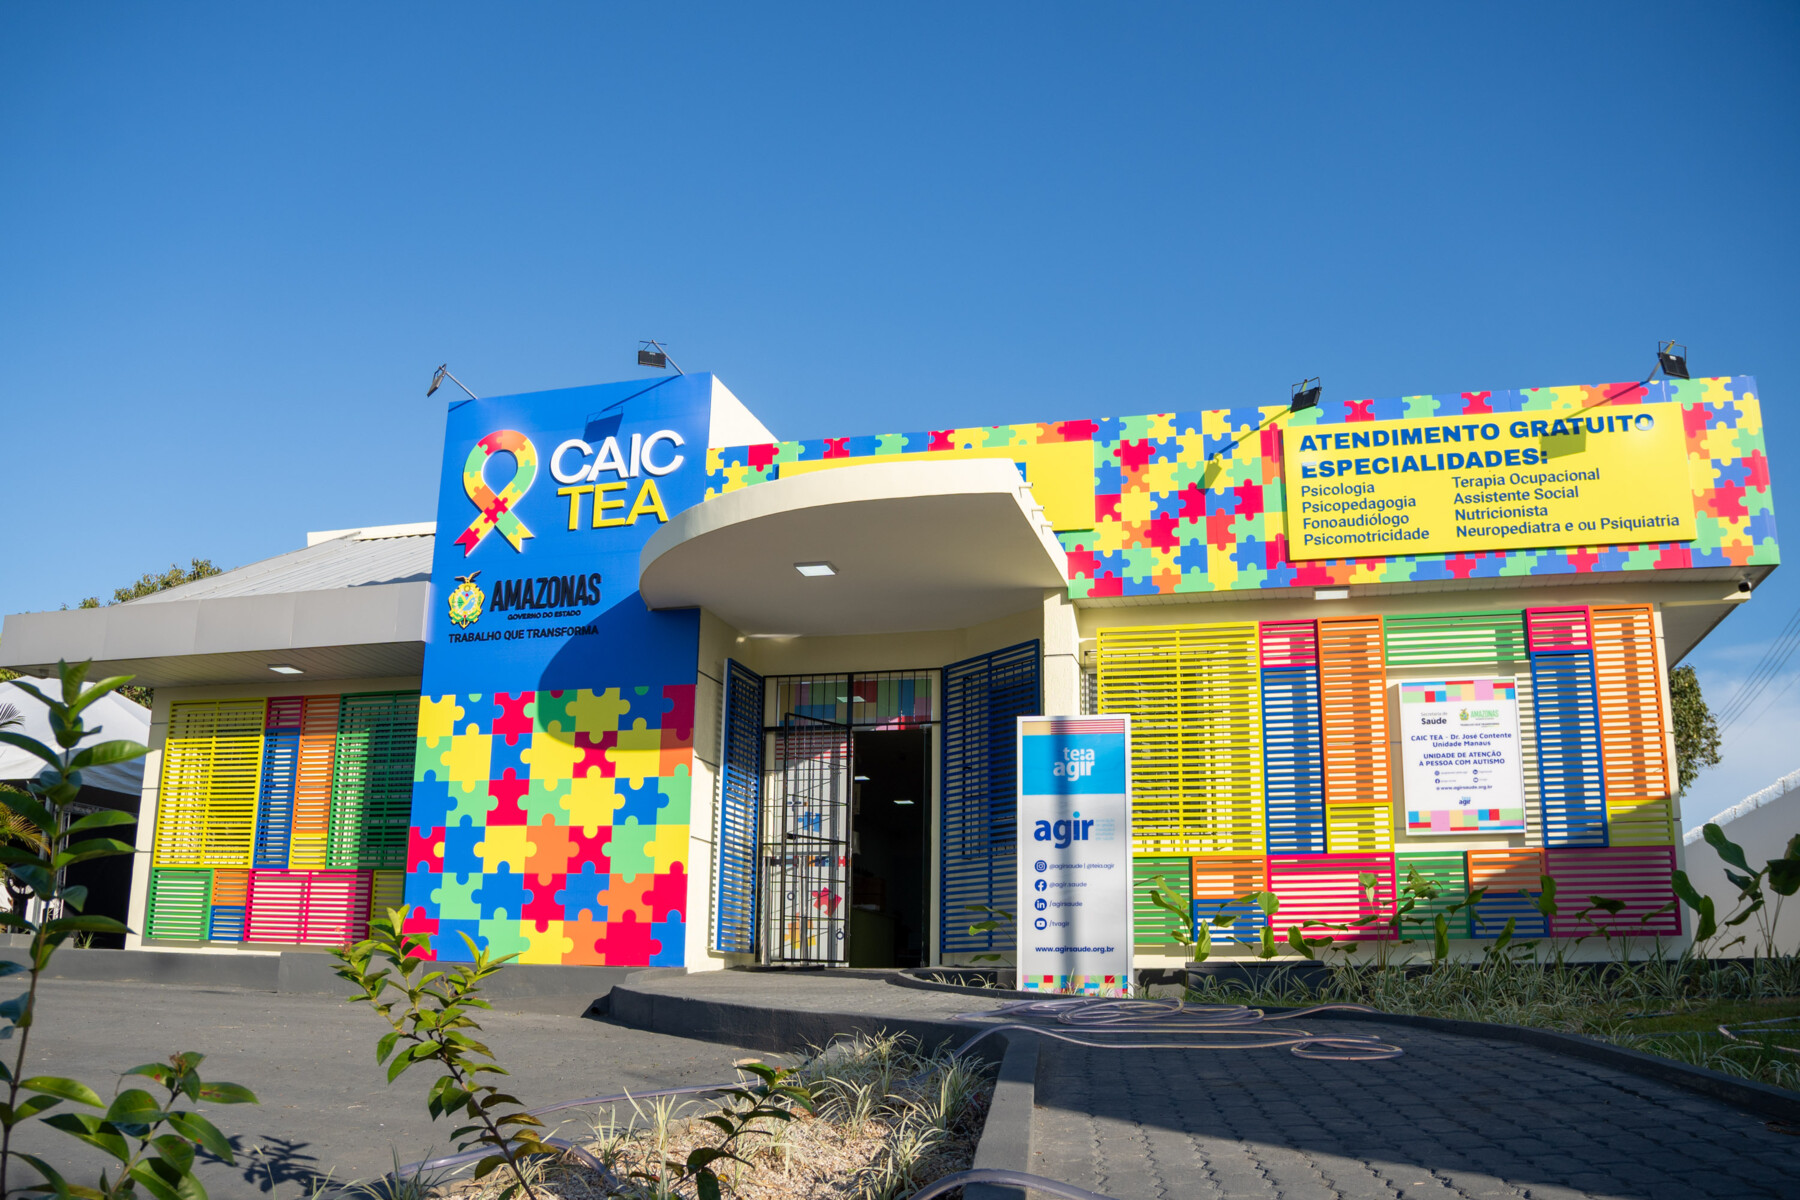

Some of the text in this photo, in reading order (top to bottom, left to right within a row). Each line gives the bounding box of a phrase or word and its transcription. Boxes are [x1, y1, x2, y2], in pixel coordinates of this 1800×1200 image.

[1299, 413, 1655, 452] ATENDIMENTO GRATUITO
[550, 429, 685, 484] CAIC
[1301, 447, 1549, 479] ESPECIALIDADES:
[1452, 467, 1600, 489] Terapia Ocupacional
[1301, 482, 1375, 497] Psicologia
[1453, 485, 1579, 505] Assistente Social
[557, 478, 669, 531] TEA
[1302, 496, 1417, 513] Psicopedagogia
[1455, 505, 1548, 521] Nutricionista
[1303, 512, 1410, 530] Fonoaudiólogo
[1456, 514, 1680, 538] Neuropediatra e ou Psiquiatria
[1304, 527, 1430, 546] Psicomotricidade
[489, 572, 602, 613] AMAZONAS
[507, 609, 581, 620] GOVERNO DO ESTADO
[449, 625, 599, 643] TRABALHO QUE TRANSFORMA
[1421, 717, 1447, 725] Saúde
[1470, 709, 1499, 718] AMAZONAS
[1468, 750, 1502, 759] ATENÇÃO
[1053, 761, 1095, 782] agir
[1034, 811, 1094, 849] agir
[1035, 946, 1114, 954] www.agirsaude.org.br
